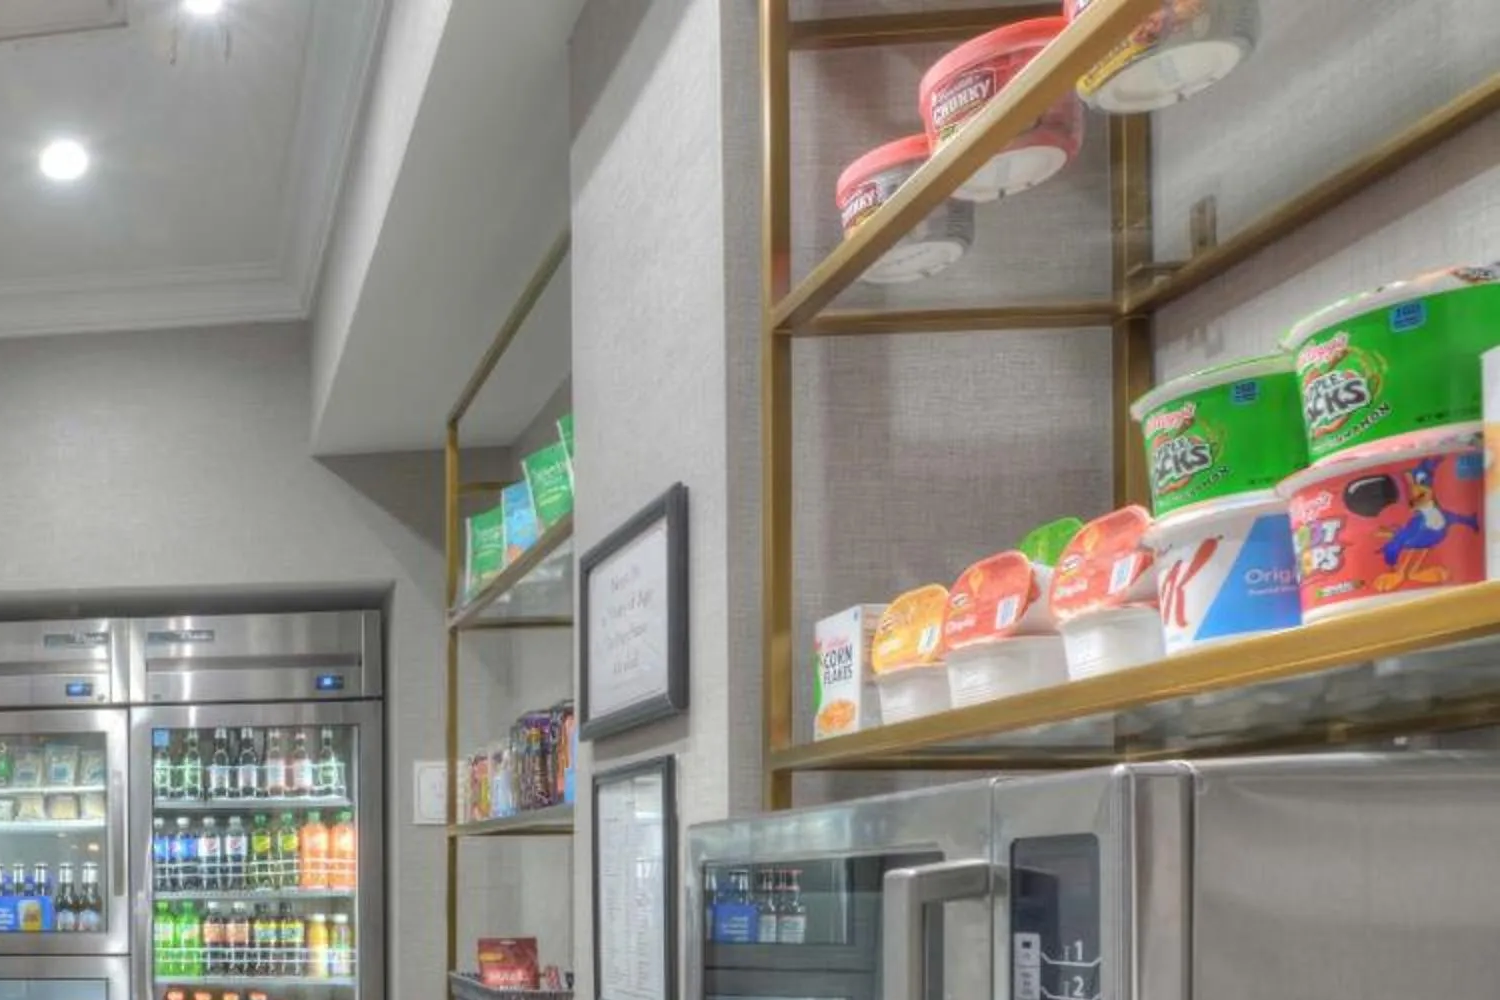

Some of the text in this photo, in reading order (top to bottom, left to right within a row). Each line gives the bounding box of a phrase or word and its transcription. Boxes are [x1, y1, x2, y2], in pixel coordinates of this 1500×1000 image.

[823, 645, 853, 668] CORN
[823, 664, 853, 687] FLAKES
[1074, 941, 1085, 961] 1
[1074, 976, 1085, 996] 2
